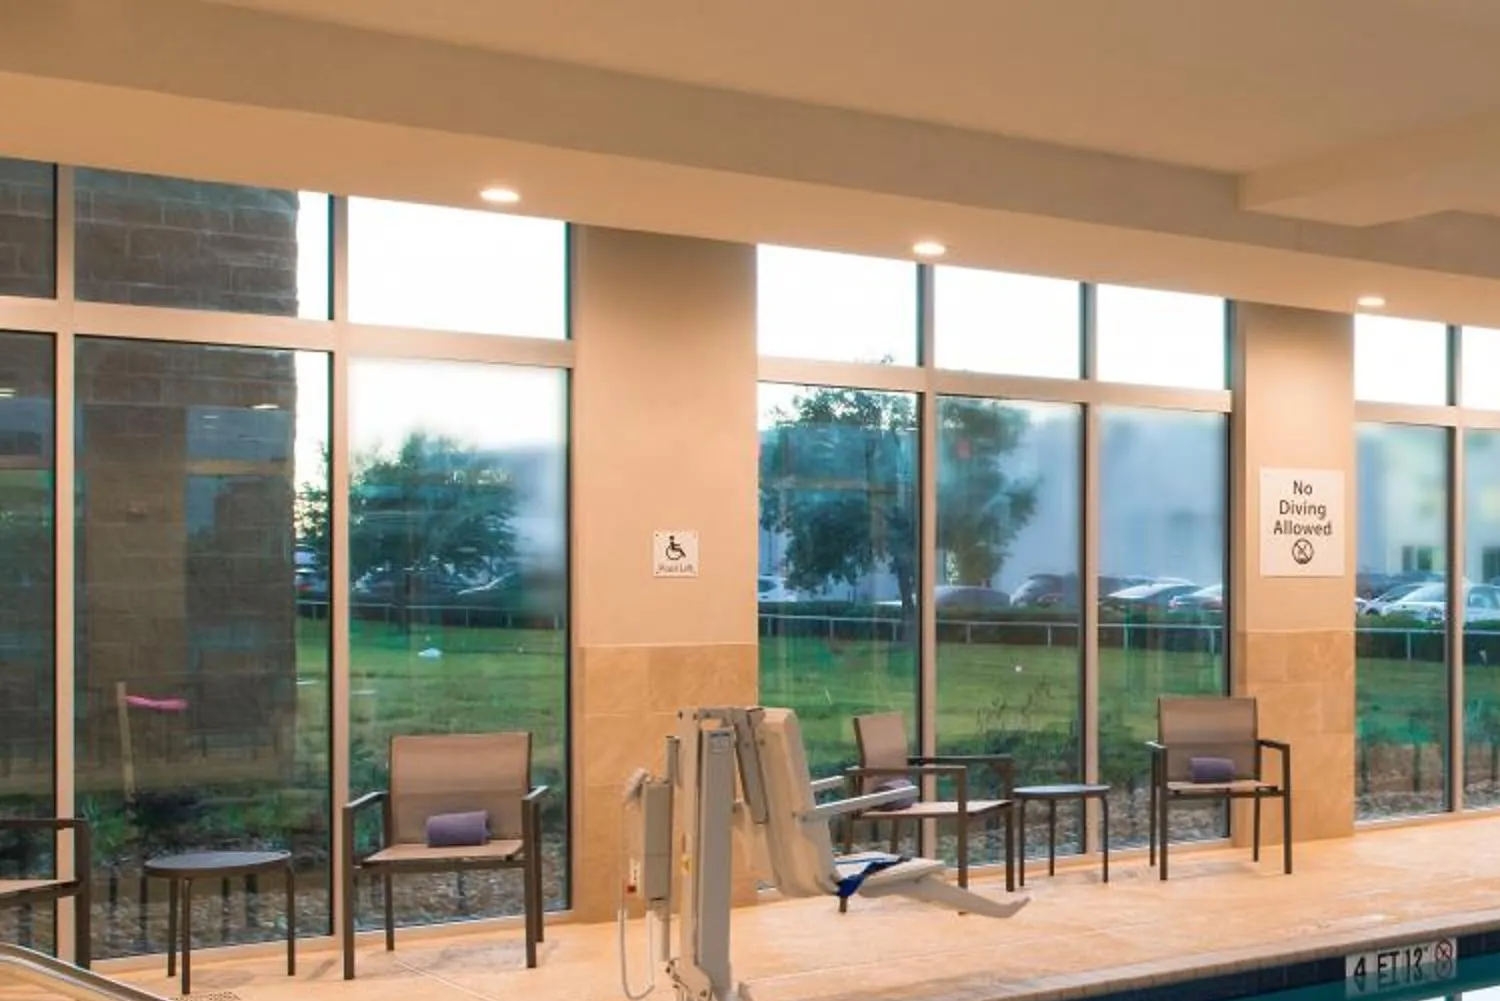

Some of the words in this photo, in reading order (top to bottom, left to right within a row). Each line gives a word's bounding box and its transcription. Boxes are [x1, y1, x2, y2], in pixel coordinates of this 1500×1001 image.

[1293, 480, 1313, 496] No
[1279, 499, 1327, 520] Diving
[1273, 519, 1333, 536] Allowed
[1354, 956, 1366, 976] 4
